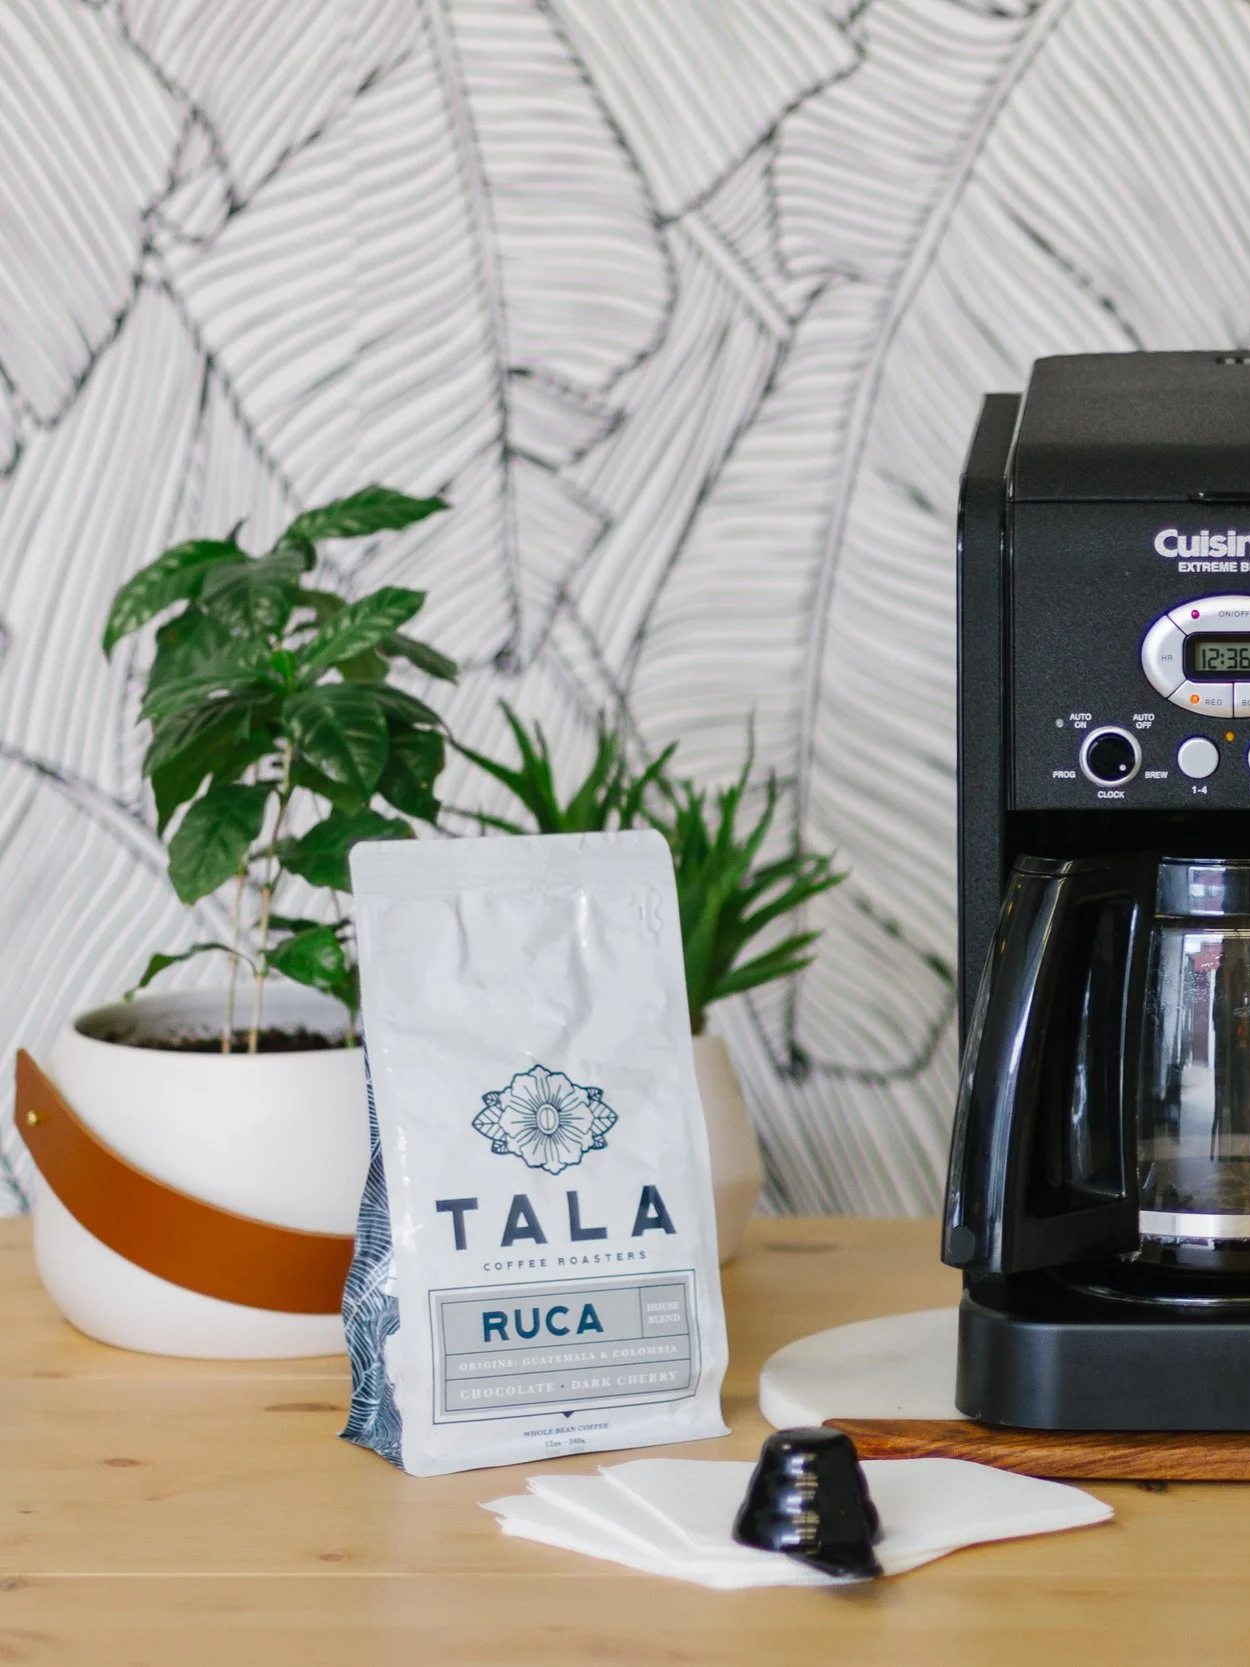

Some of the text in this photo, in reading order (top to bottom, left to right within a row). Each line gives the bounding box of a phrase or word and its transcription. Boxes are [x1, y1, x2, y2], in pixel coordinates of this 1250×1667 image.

[1178, 562, 1237, 573] EXTREME
[1218, 610, 1250, 618] ON/OFF
[1161, 654, 1173, 662] HR
[1205, 698, 1223, 706] REG
[1069, 713, 1092, 721] AUTO
[1132, 713, 1155, 721] AUTO
[1074, 721, 1087, 729] ON
[1135, 721, 1152, 729] OFF
[1052, 770, 1076, 779] PROG
[1144, 771, 1168, 779] BREW
[1097, 790, 1125, 799] CLOCK
[1191, 785, 1208, 795] 1-4
[435, 1184, 677, 1251] TALA
[483, 1250, 647, 1272] COFFEE ROASTERS
[482, 1303, 604, 1343] RUCA
[648, 1313, 680, 1324] BLEND
[522, 1352, 596, 1367] GUATEMALA
[612, 1345, 678, 1358] COLOMBIA
[459, 1371, 678, 1401] CHOCOLATE DARK CHERRY
[523, 1422, 609, 1437] WHOLE BEAN COFFEE
